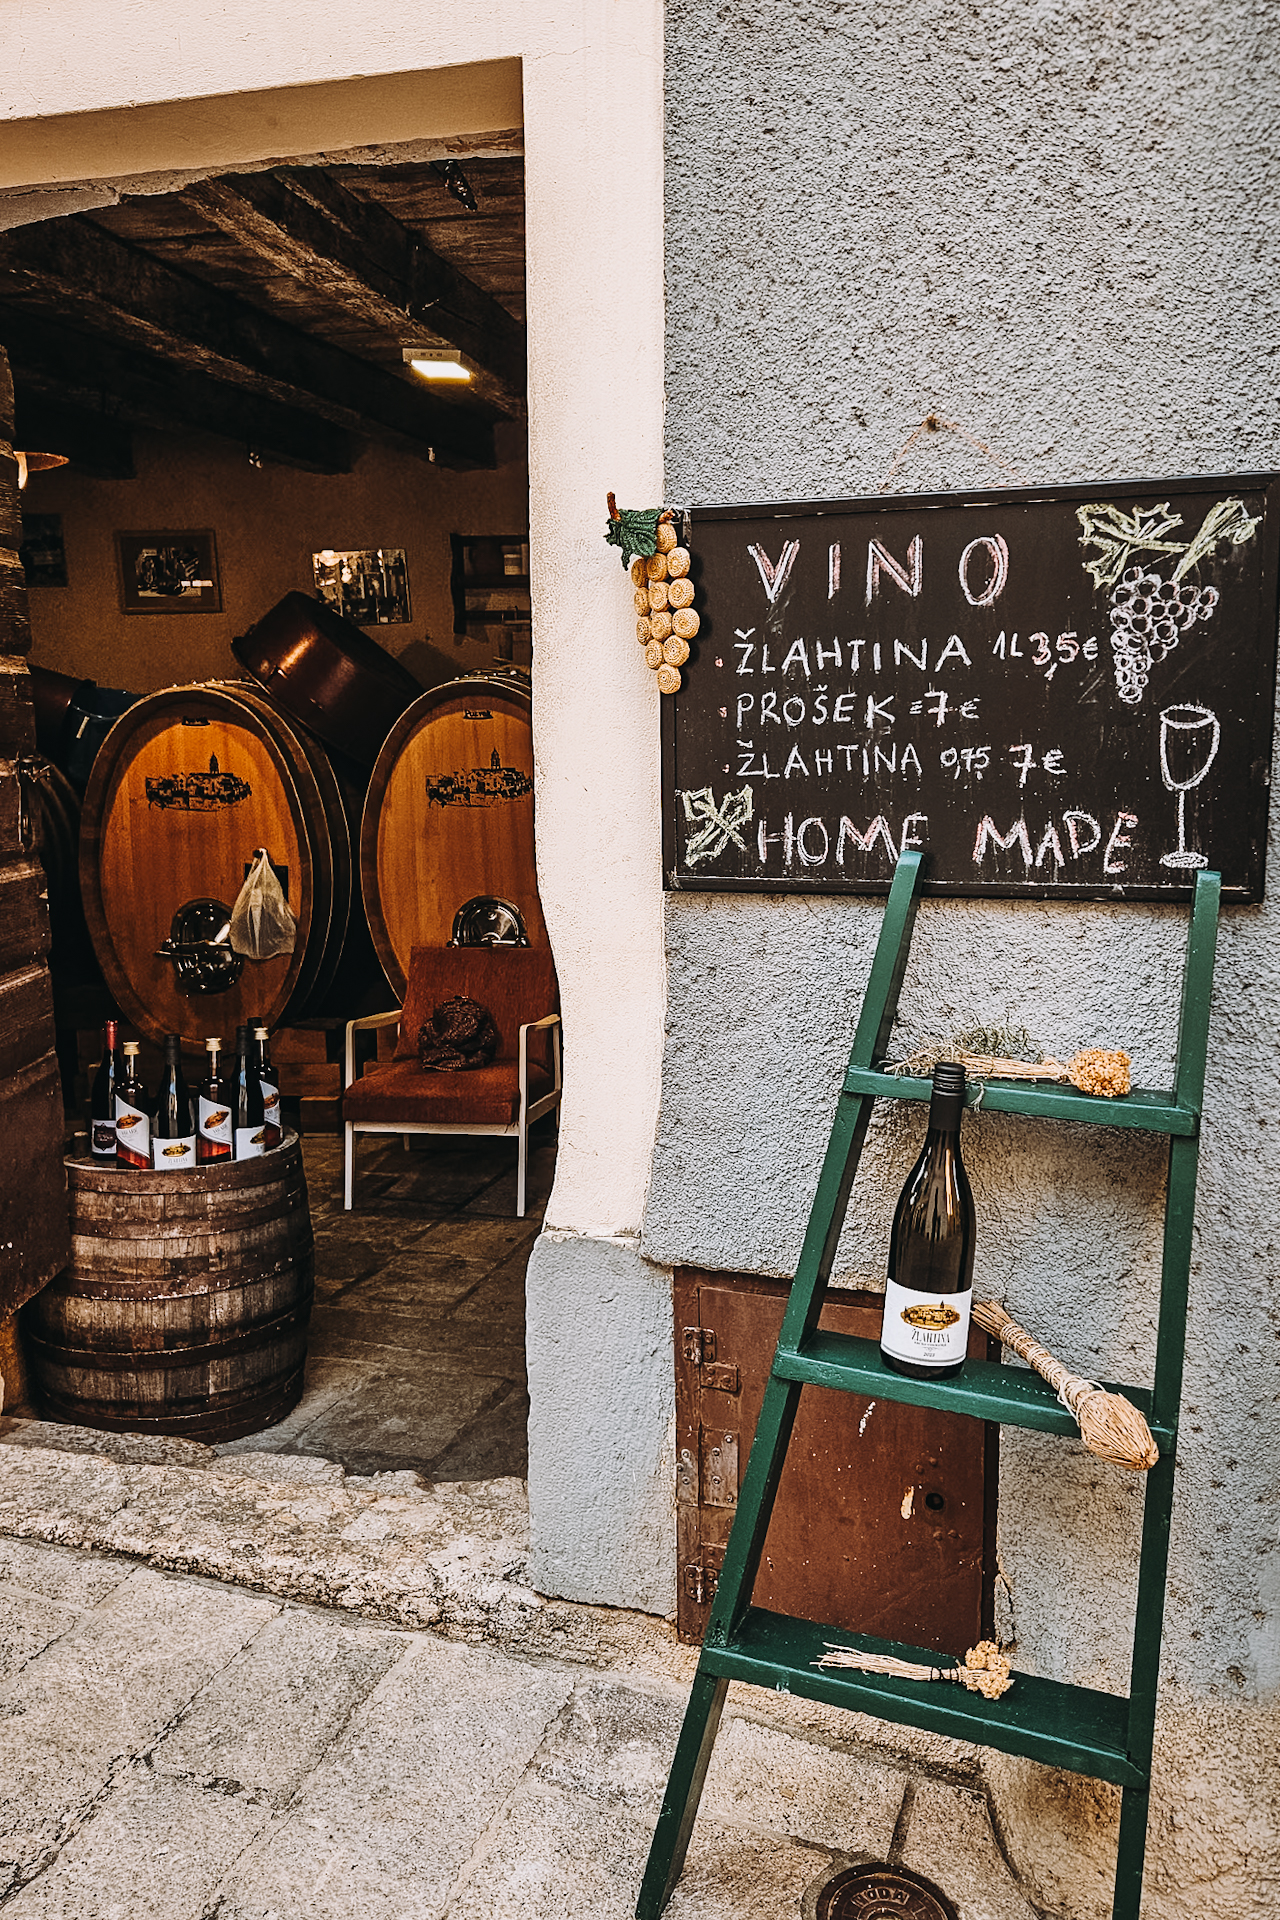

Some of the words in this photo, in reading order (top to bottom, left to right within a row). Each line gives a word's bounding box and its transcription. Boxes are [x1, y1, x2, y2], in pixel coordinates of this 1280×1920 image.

[746, 534, 1010, 606] VINO
[733, 627, 973, 676] ŽLAHTINA
[736, 684, 896, 729] PROŠEK
[736, 738, 923, 779] ŽLAHTINA
[757, 811, 929, 867] HOME
[972, 811, 1140, 874] MADE
